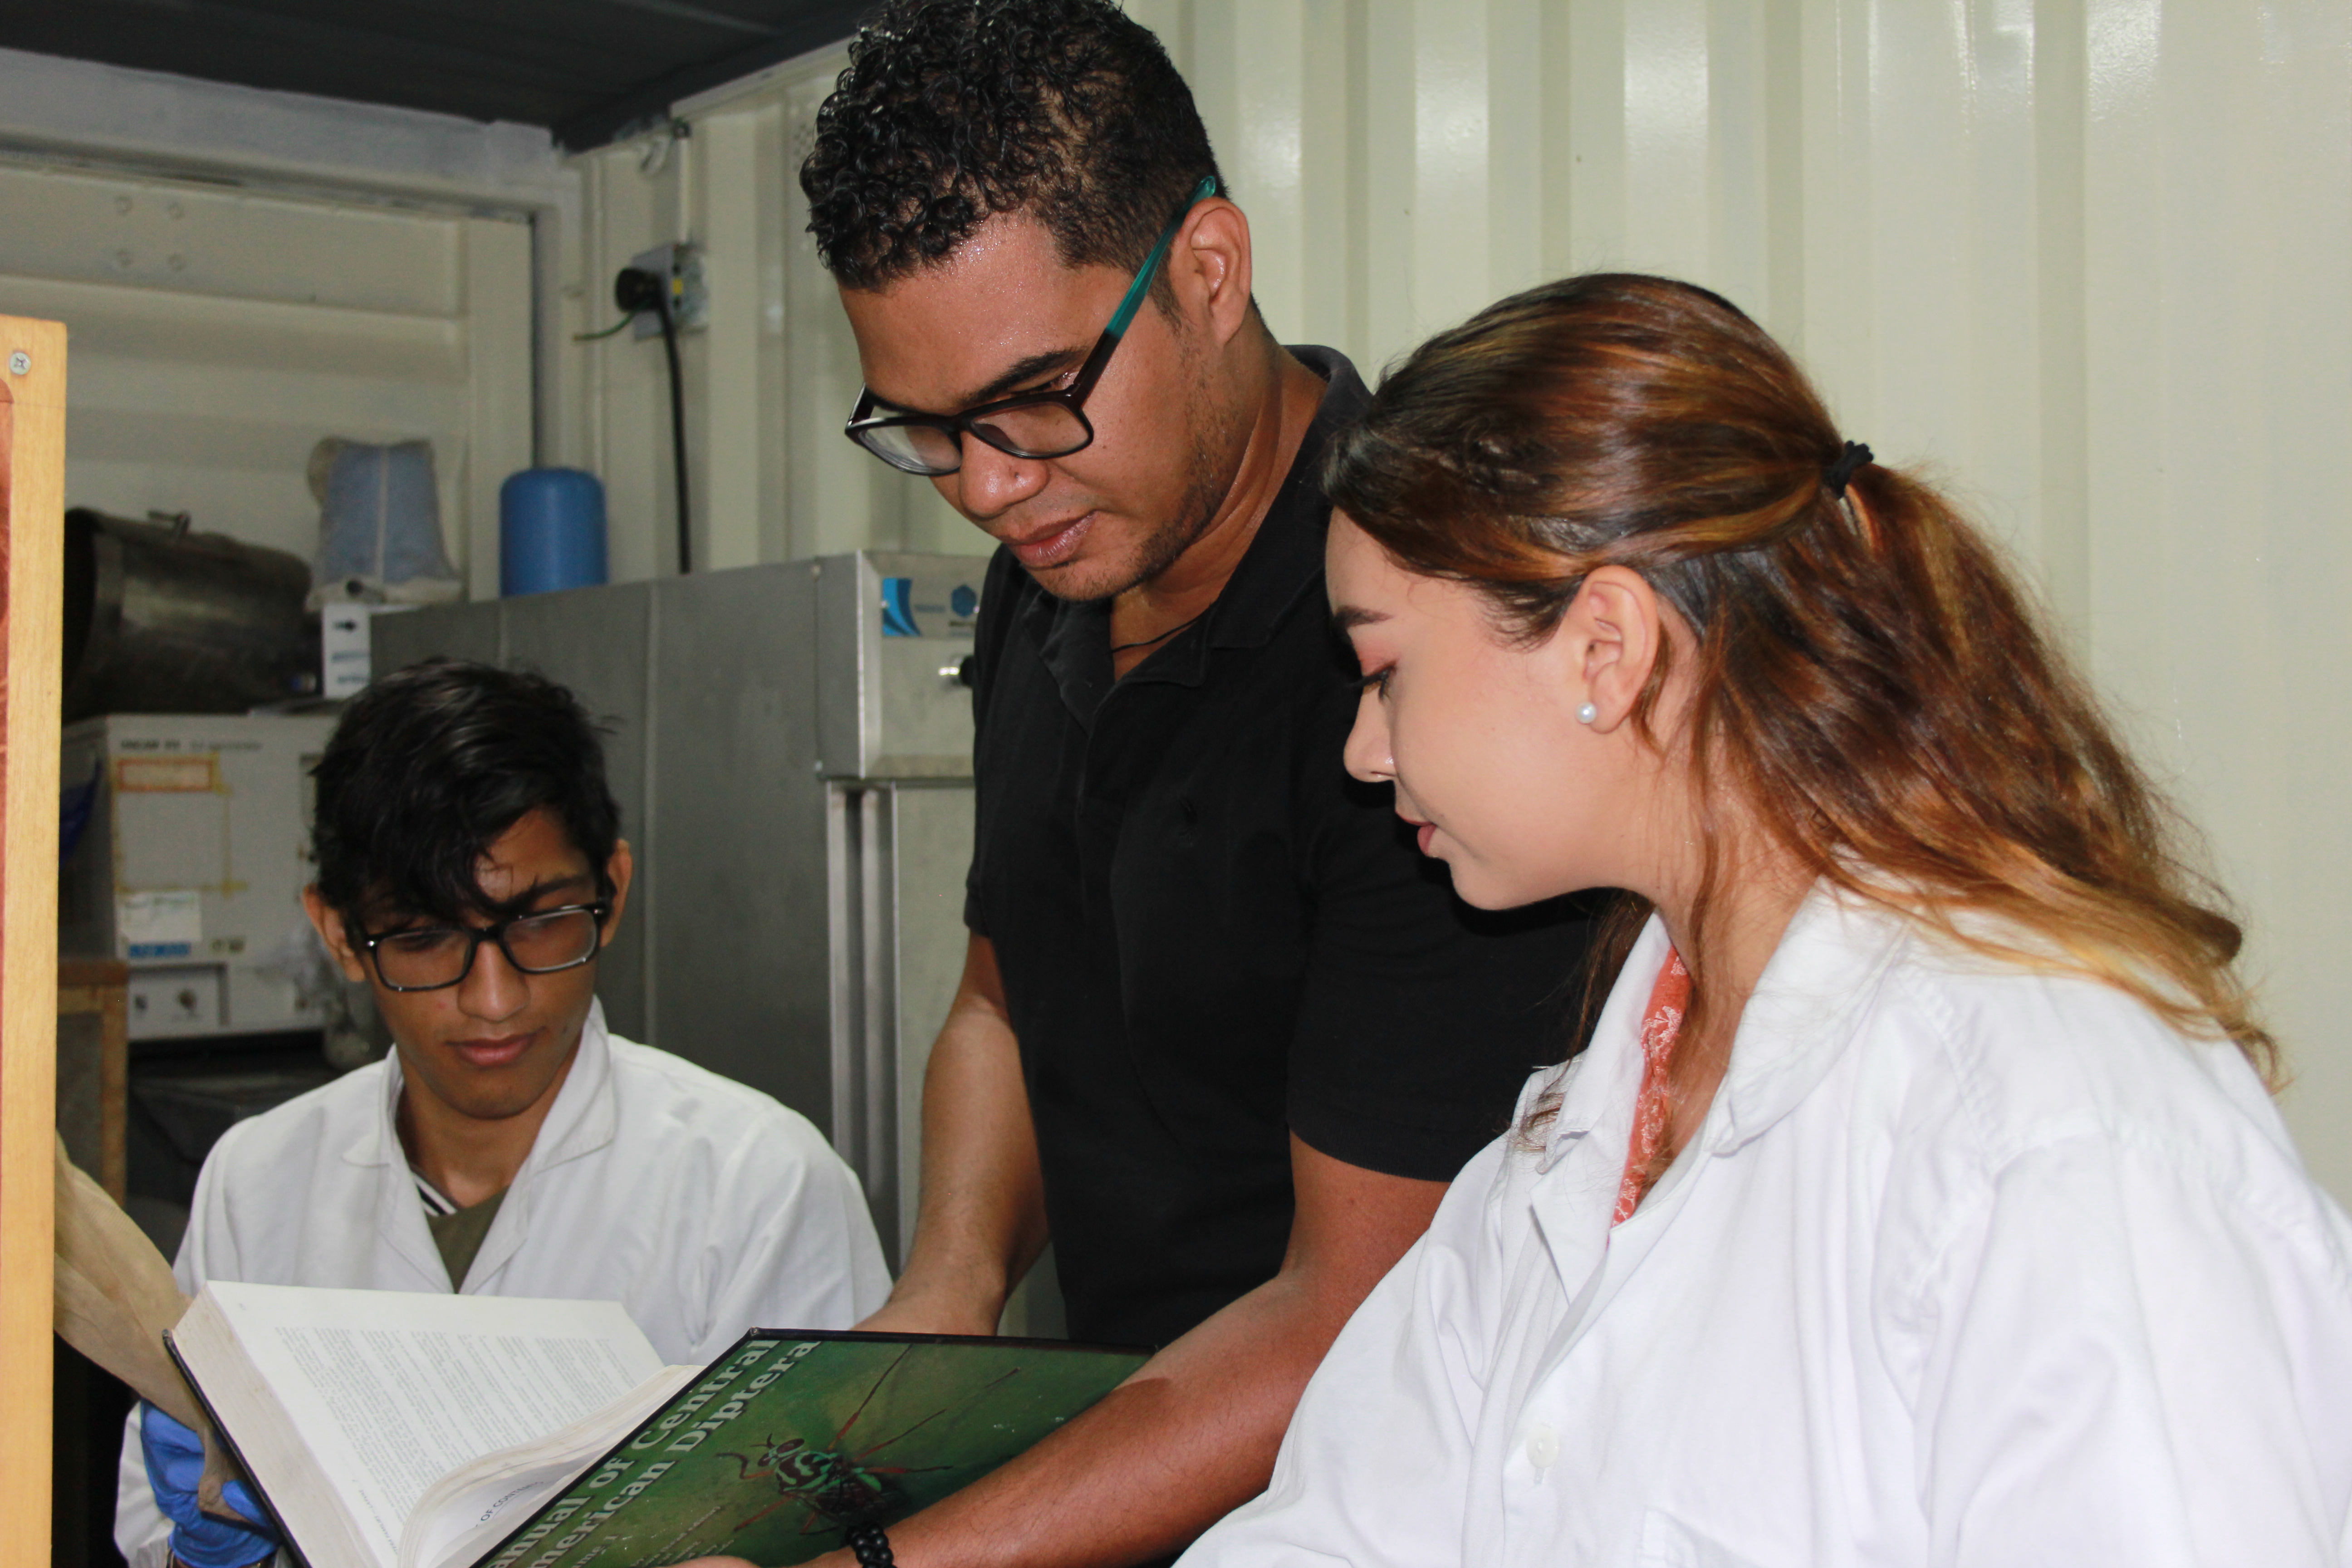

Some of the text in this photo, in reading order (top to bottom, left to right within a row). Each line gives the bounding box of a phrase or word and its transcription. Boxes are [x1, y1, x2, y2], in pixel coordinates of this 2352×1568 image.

[480, 1509, 494, 1521] OF
[485, 1496, 591, 1568] anual
[588, 1458, 635, 1488] of
[631, 1340, 781, 1450] Central
[526, 1460, 676, 1568] merican
[665, 1341, 821, 1452] Diptera
